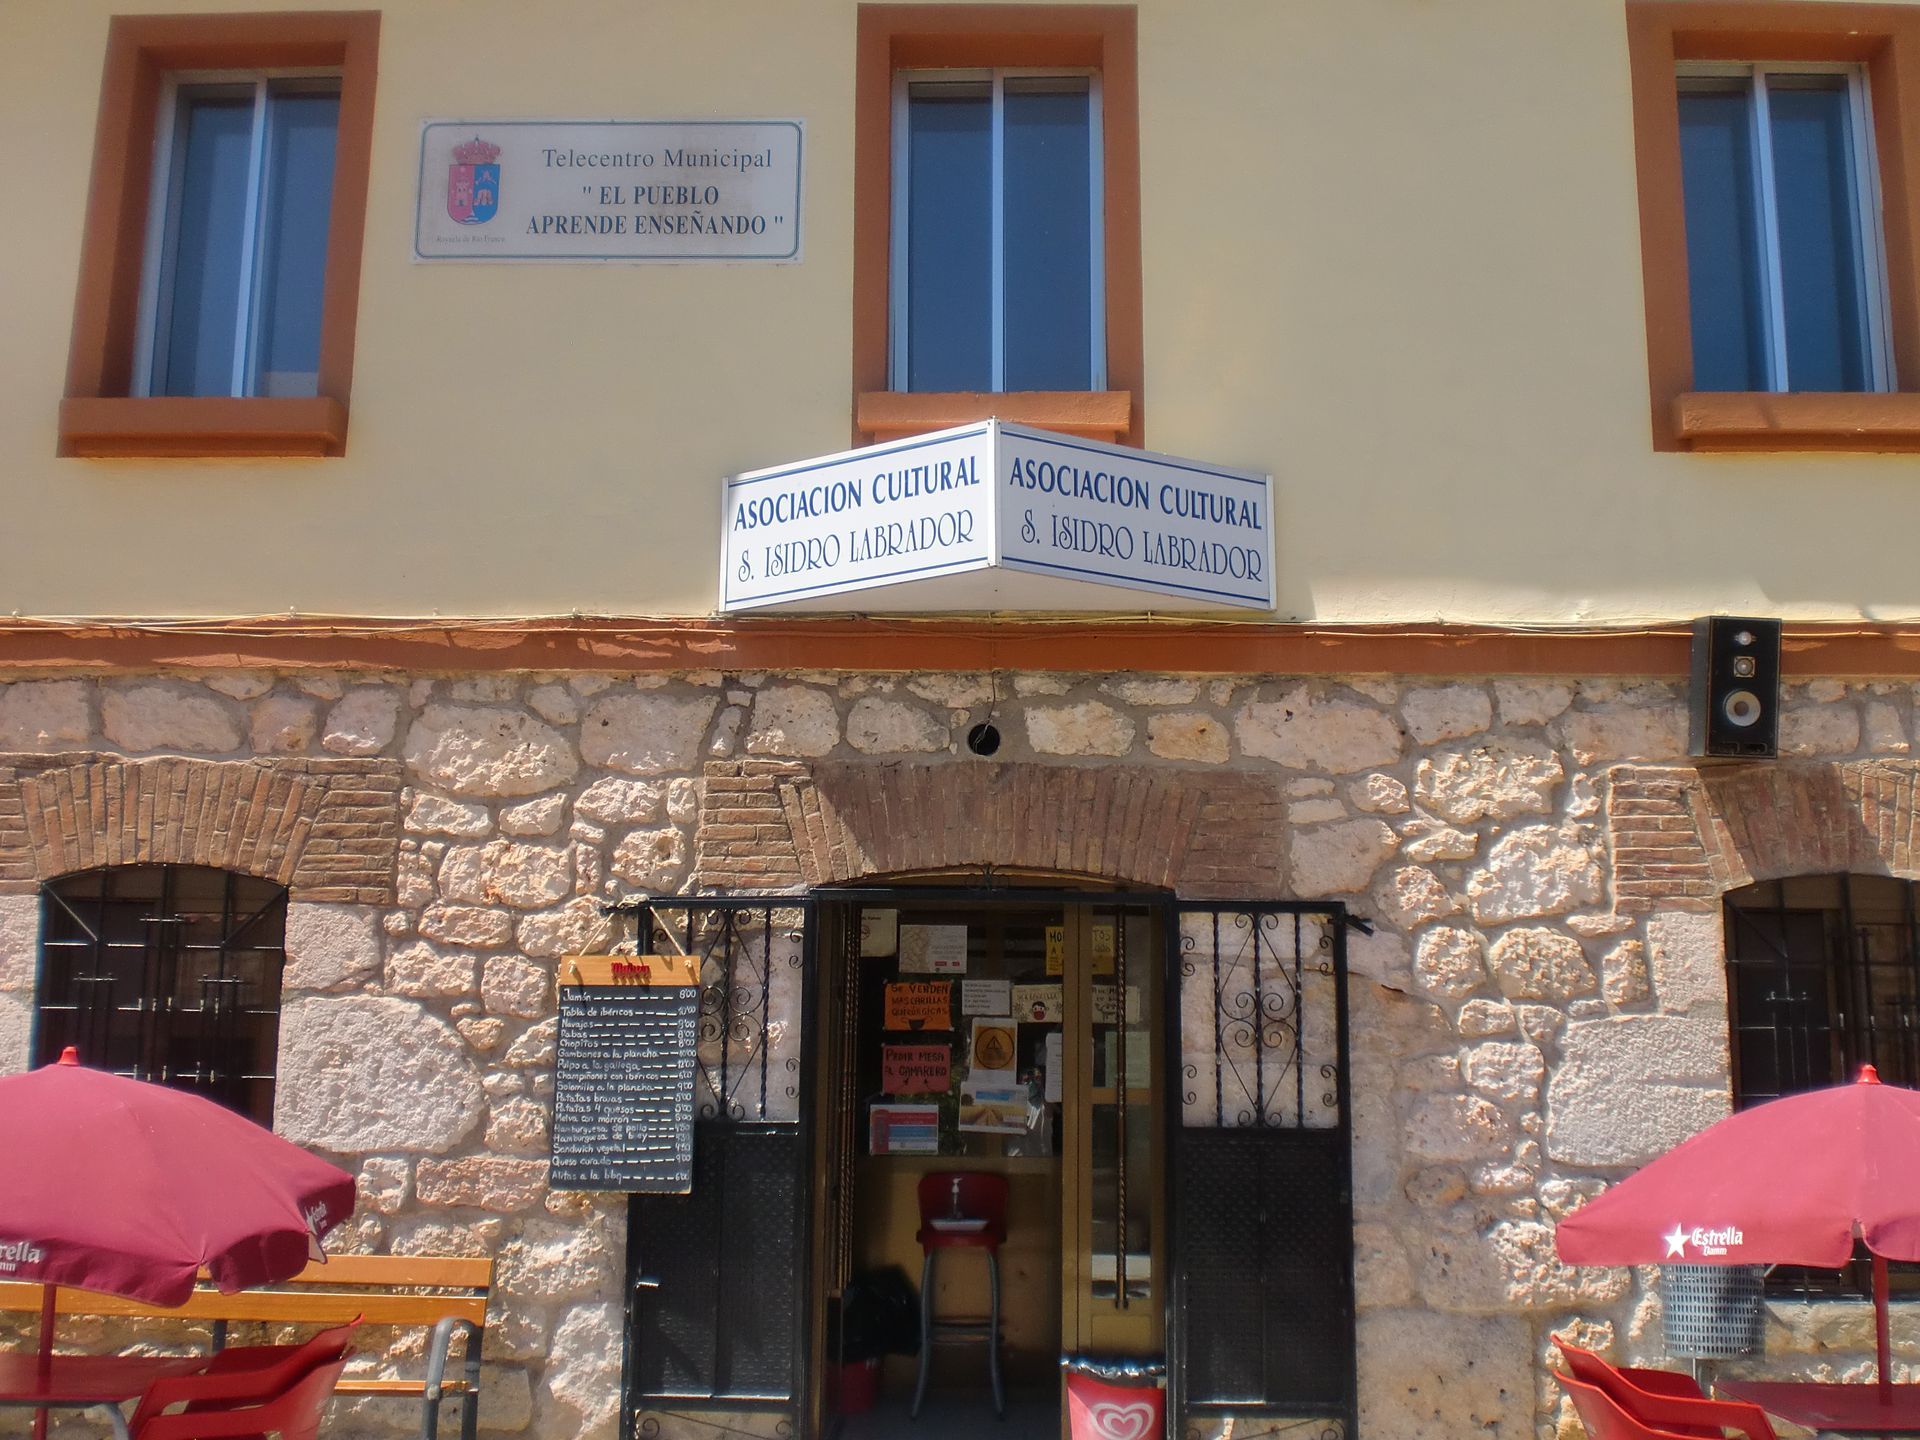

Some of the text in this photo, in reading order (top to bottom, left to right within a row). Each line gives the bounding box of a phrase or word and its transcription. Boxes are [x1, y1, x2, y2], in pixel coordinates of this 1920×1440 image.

[542, 148, 772, 173] Telecentro Municipal
[599, 186, 627, 206] EL
[634, 186, 720, 206] PUEBLO
[526, 215, 627, 235] APRENDE
[635, 210, 767, 235] ENSEÑANDO
[734, 455, 981, 532] ASOCIACION CULTURAL
[1010, 457, 1262, 530] ASOCIACION CULTURAL
[738, 510, 974, 583] S. ISIDRO LABRADOR
[1021, 510, 1262, 582] S. ISIDRO LABRADOR
[563, 988, 591, 1001] Jamón
[561, 1007, 584, 1017] Tabla
[587, 1007, 597, 1017] de
[562, 1019, 594, 1031] Navajas
[560, 1039, 599, 1050] Chopitos
[612, 1049, 622, 1059] la
[624, 1048, 660, 1060] plancha
[628, 1132, 648, 1144] bey
[553, 1143, 594, 1154] Sandwich
[552, 1156, 577, 1167] Queso
[1691, 1226, 1743, 1247] Estrella
